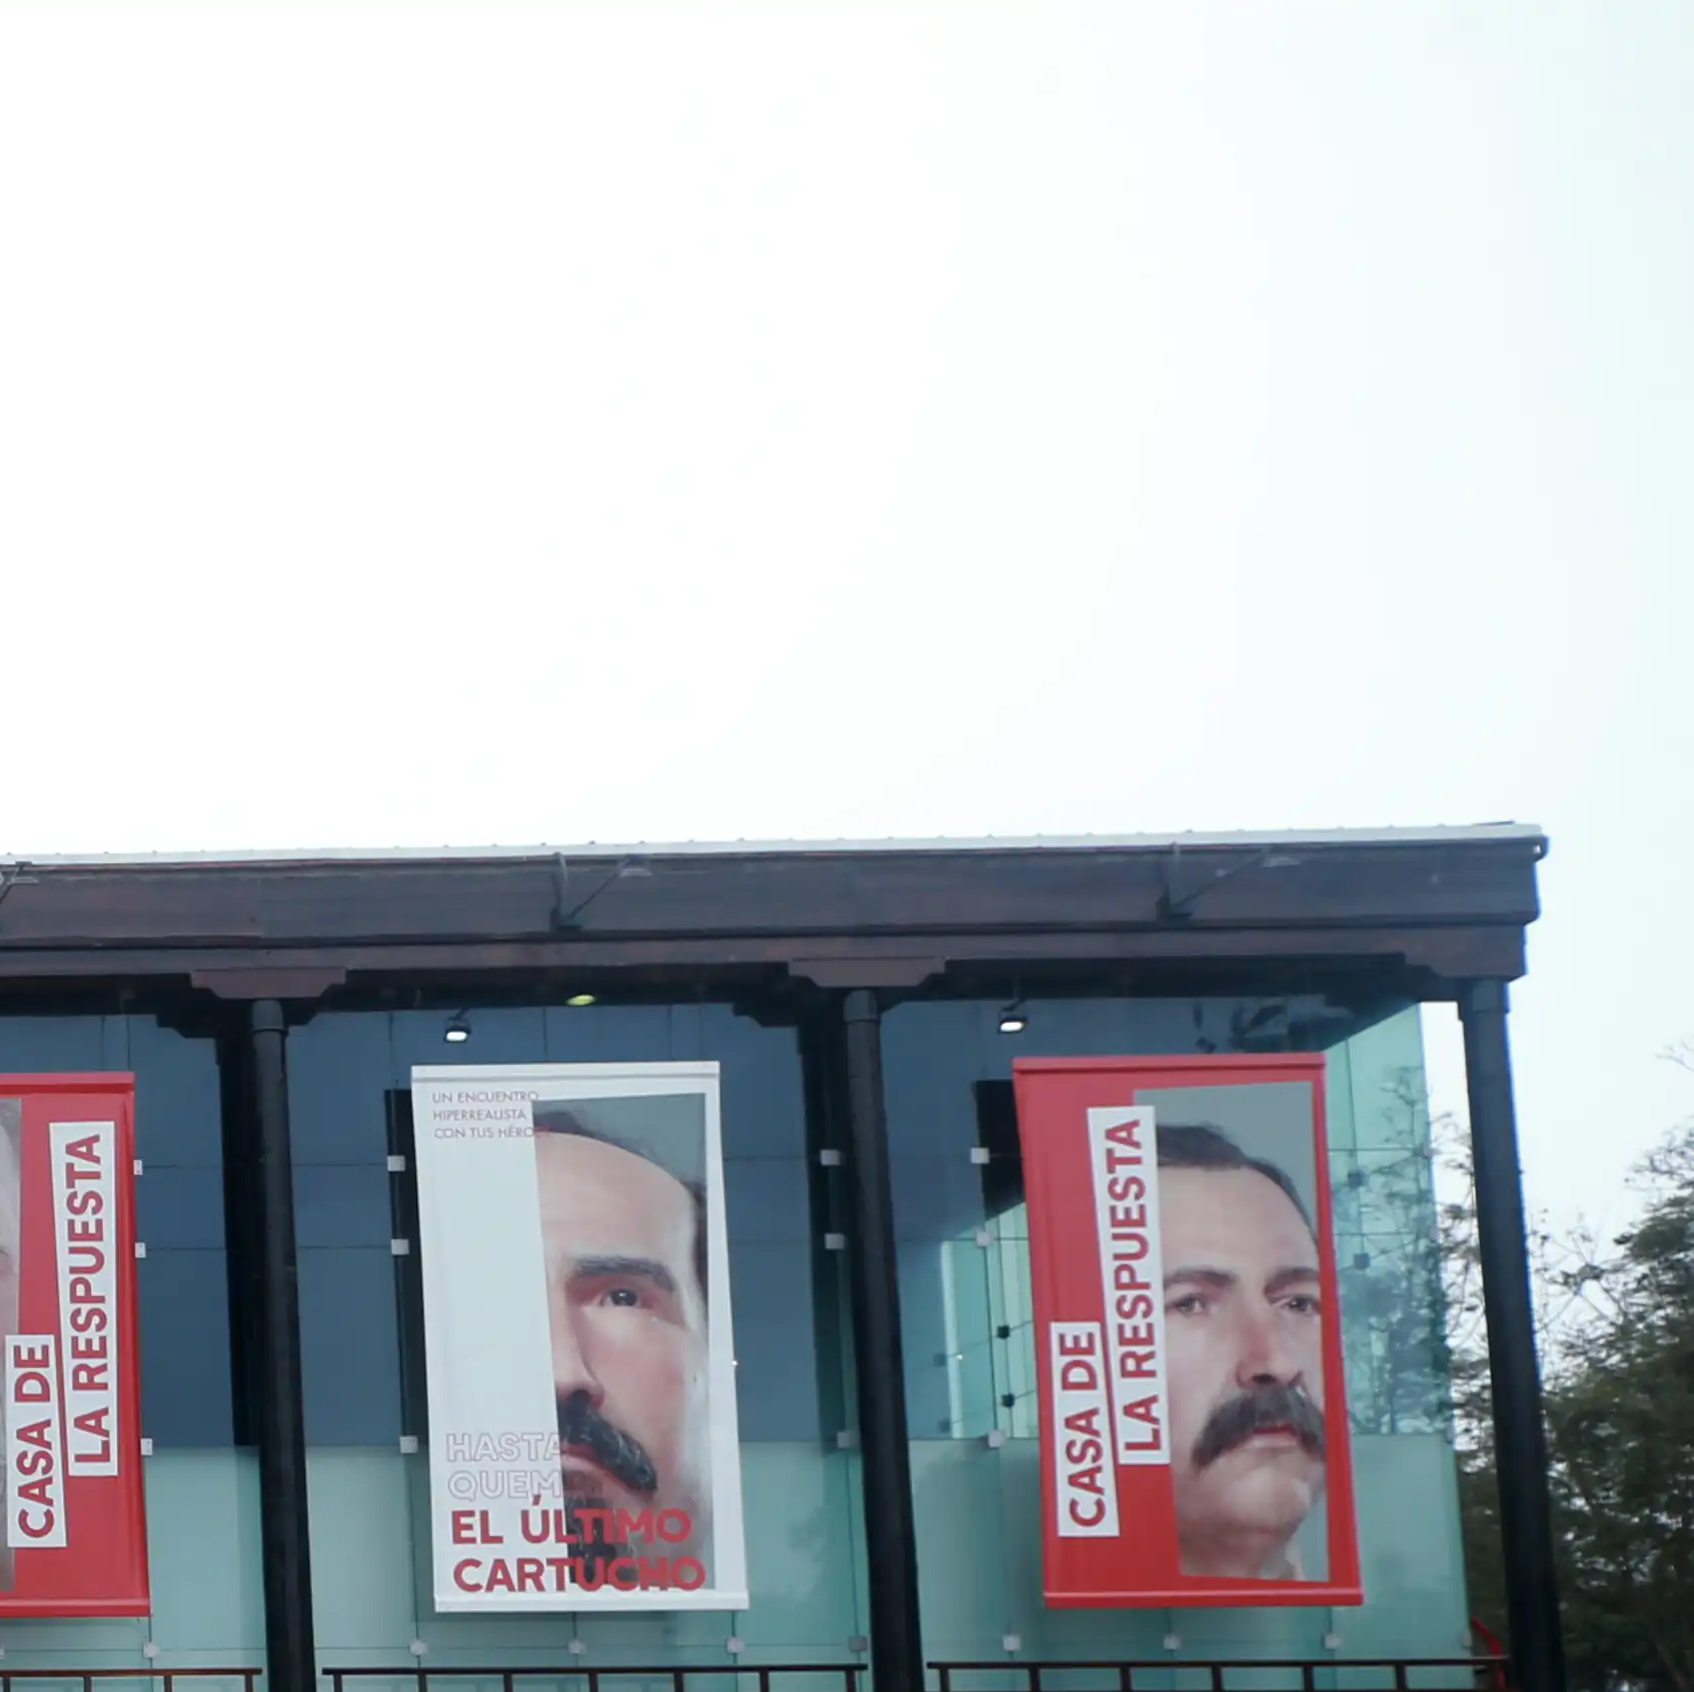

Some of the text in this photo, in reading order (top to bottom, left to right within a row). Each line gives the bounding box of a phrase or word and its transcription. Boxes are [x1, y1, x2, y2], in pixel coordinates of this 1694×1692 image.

[432, 1091, 539, 1104] UN ENCUENTRO
[433, 1109, 527, 1121] HIPERREALISTA
[434, 1128, 466, 1139] CON
[471, 1127, 494, 1139] TUS
[65, 1134, 111, 1463] LA RESPUESTA
[1104, 1119, 1161, 1451] LA RESPUESTA
[13, 1344, 54, 1538] CASA DE
[446, 1431, 563, 1462] HASTA
[1058, 1332, 1106, 1526] CASA DE
[451, 1494, 692, 1544] EL ÚLTIMO
[453, 1555, 705, 1593] CARTUCHO
